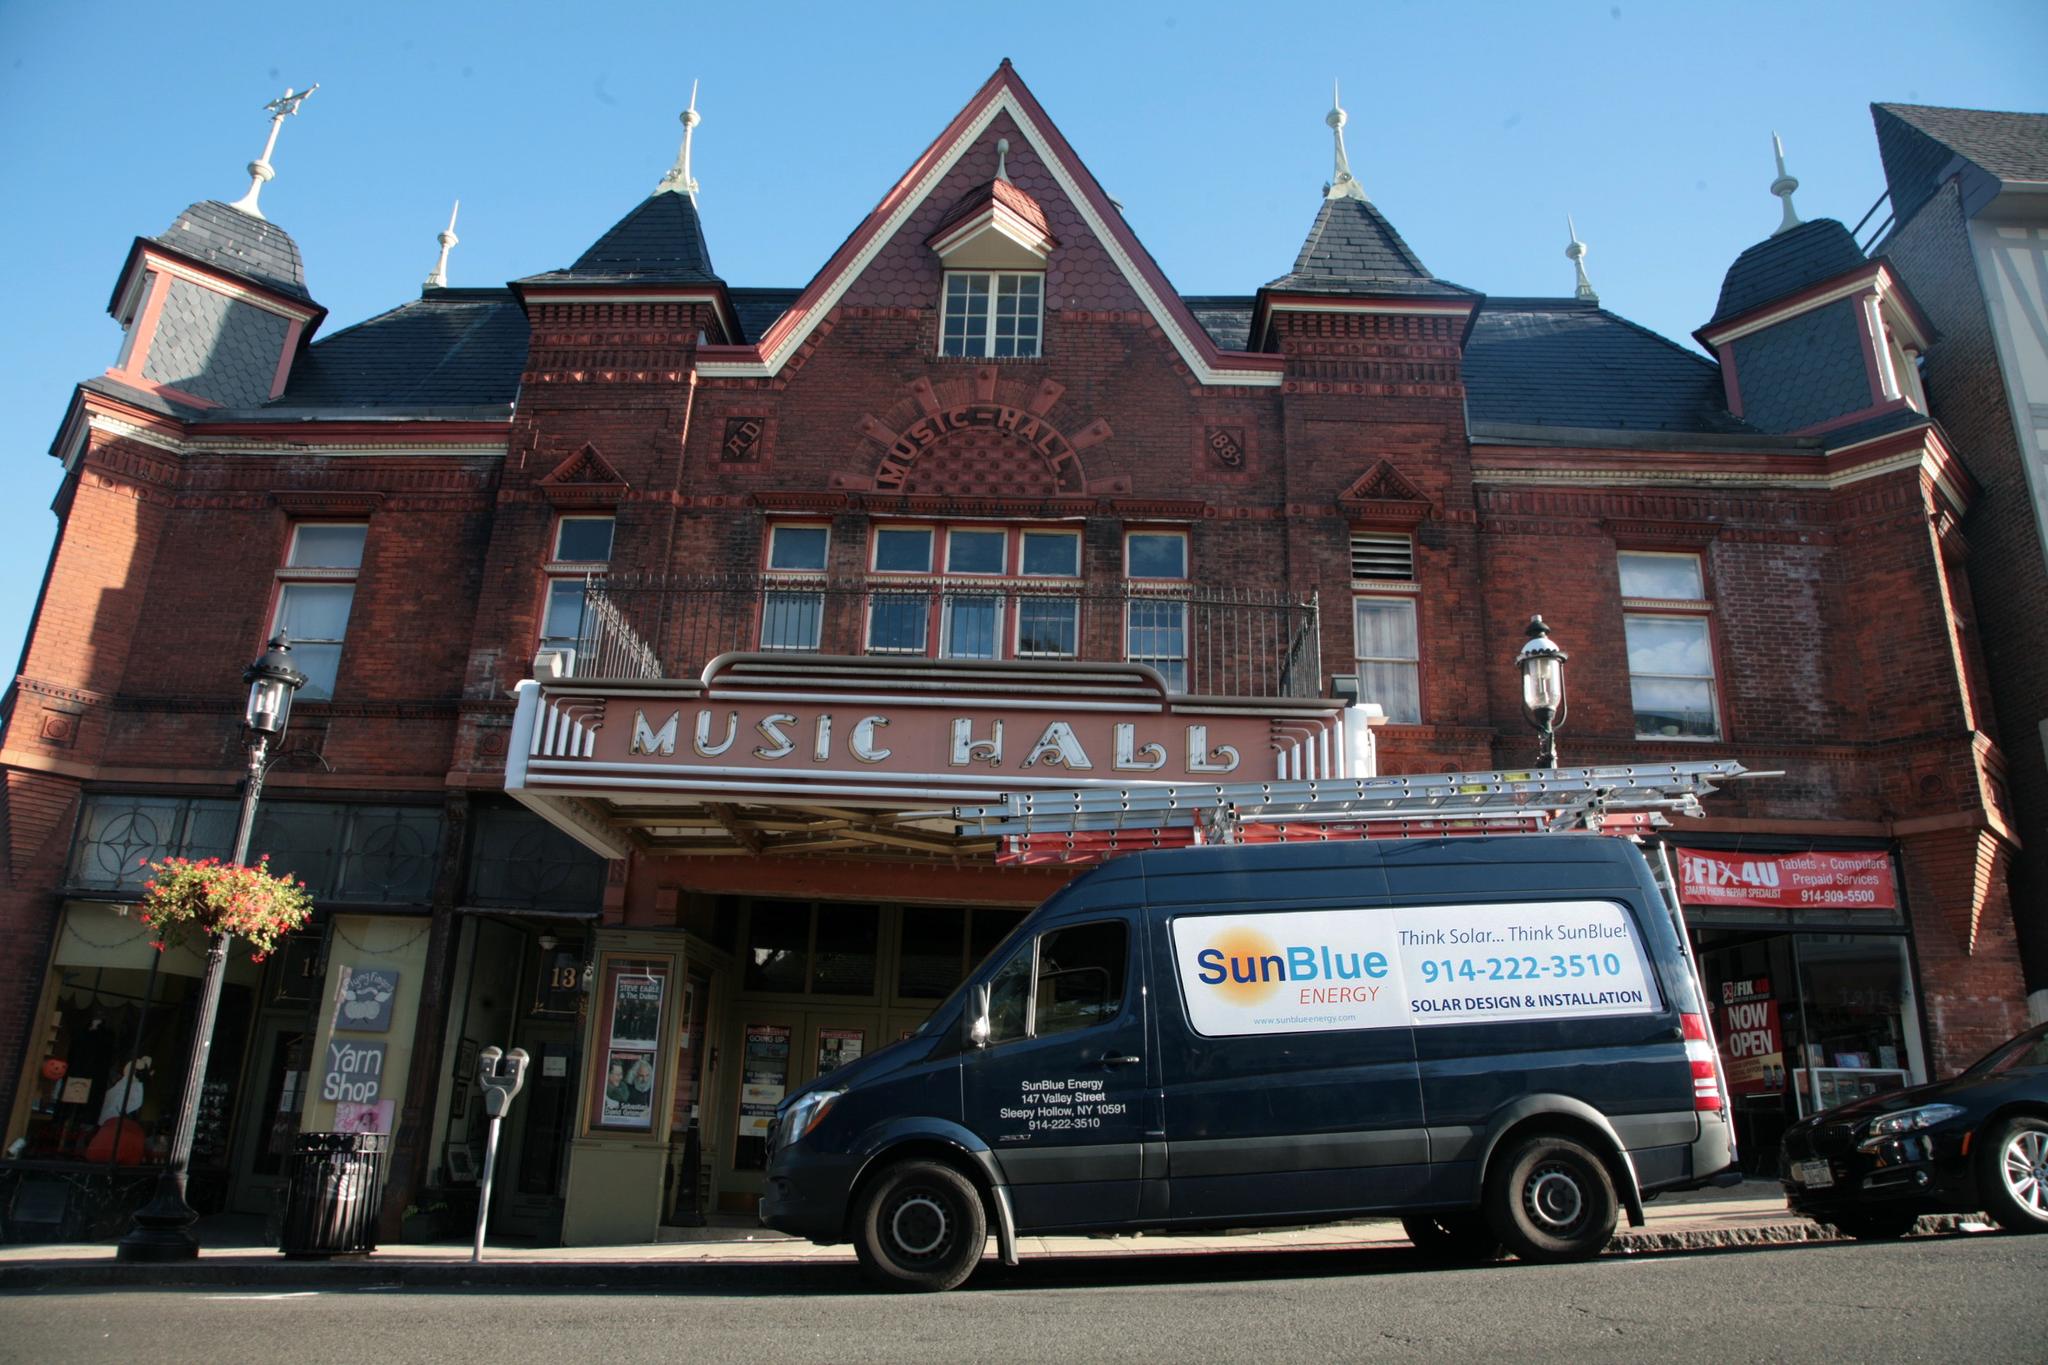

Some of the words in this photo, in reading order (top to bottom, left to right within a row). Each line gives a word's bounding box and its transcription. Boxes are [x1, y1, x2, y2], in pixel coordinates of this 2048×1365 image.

[1209, 430, 1240, 465] 1885
[629, 707, 892, 764] MUSIC
[948, 716, 1241, 774] HALL
[1778, 858, 1817, 870] Tablets
[1820, 861, 1827, 869] +
[1830, 858, 1887, 872] Computers
[1792, 873, 1833, 886] Prepaid
[1836, 874, 1879, 885] Services
[1707, 886, 1726, 896] PHONE
[1726, 887, 1748, 898] REPAIR
[1748, 888, 1781, 899] SPECIALIST
[1801, 889, 1875, 902] 914-909-5500
[1399, 929, 1445, 946] Think
[1449, 928, 1504, 944] Solar...
[1507, 925, 1554, 942] Think
[1557, 922, 1628, 941] SunBlue!
[1197, 945, 1388, 985] SunBlue
[1421, 953, 1621, 983] 914-222-3510
[552, 967, 577, 988] 13
[1299, 986, 1380, 1005] ENERGY
[1411, 998, 1462, 1012] SOLAR
[1465, 995, 1521, 1010] DESIGN
[1524, 995, 1536, 1008] &
[1539, 990, 1643, 1008] INSTALLATION
[1253, 1014, 1356, 1025] www.sunblueenergy.com
[1728, 1002, 1768, 1030] NOW
[1730, 1029, 1773, 1057] OPEN
[330, 1043, 382, 1075] Yarn
[323, 1072, 378, 1104] Shop
[1021, 1080, 1065, 1091] SunBlue
[1067, 1079, 1104, 1091] Energy
[1021, 1093, 1039, 1104] 147
[1042, 1092, 1072, 1105] Valley
[1075, 1091, 1106, 1102] Street
[1000, 1107, 1035, 1120] Sleepy
[1037, 1106, 1075, 1117] Hollow,
[1077, 1105, 1093, 1115] NY
[1097, 1104, 1127, 1115] 10591
[1028, 1118, 1101, 1130] 914-222-3510
